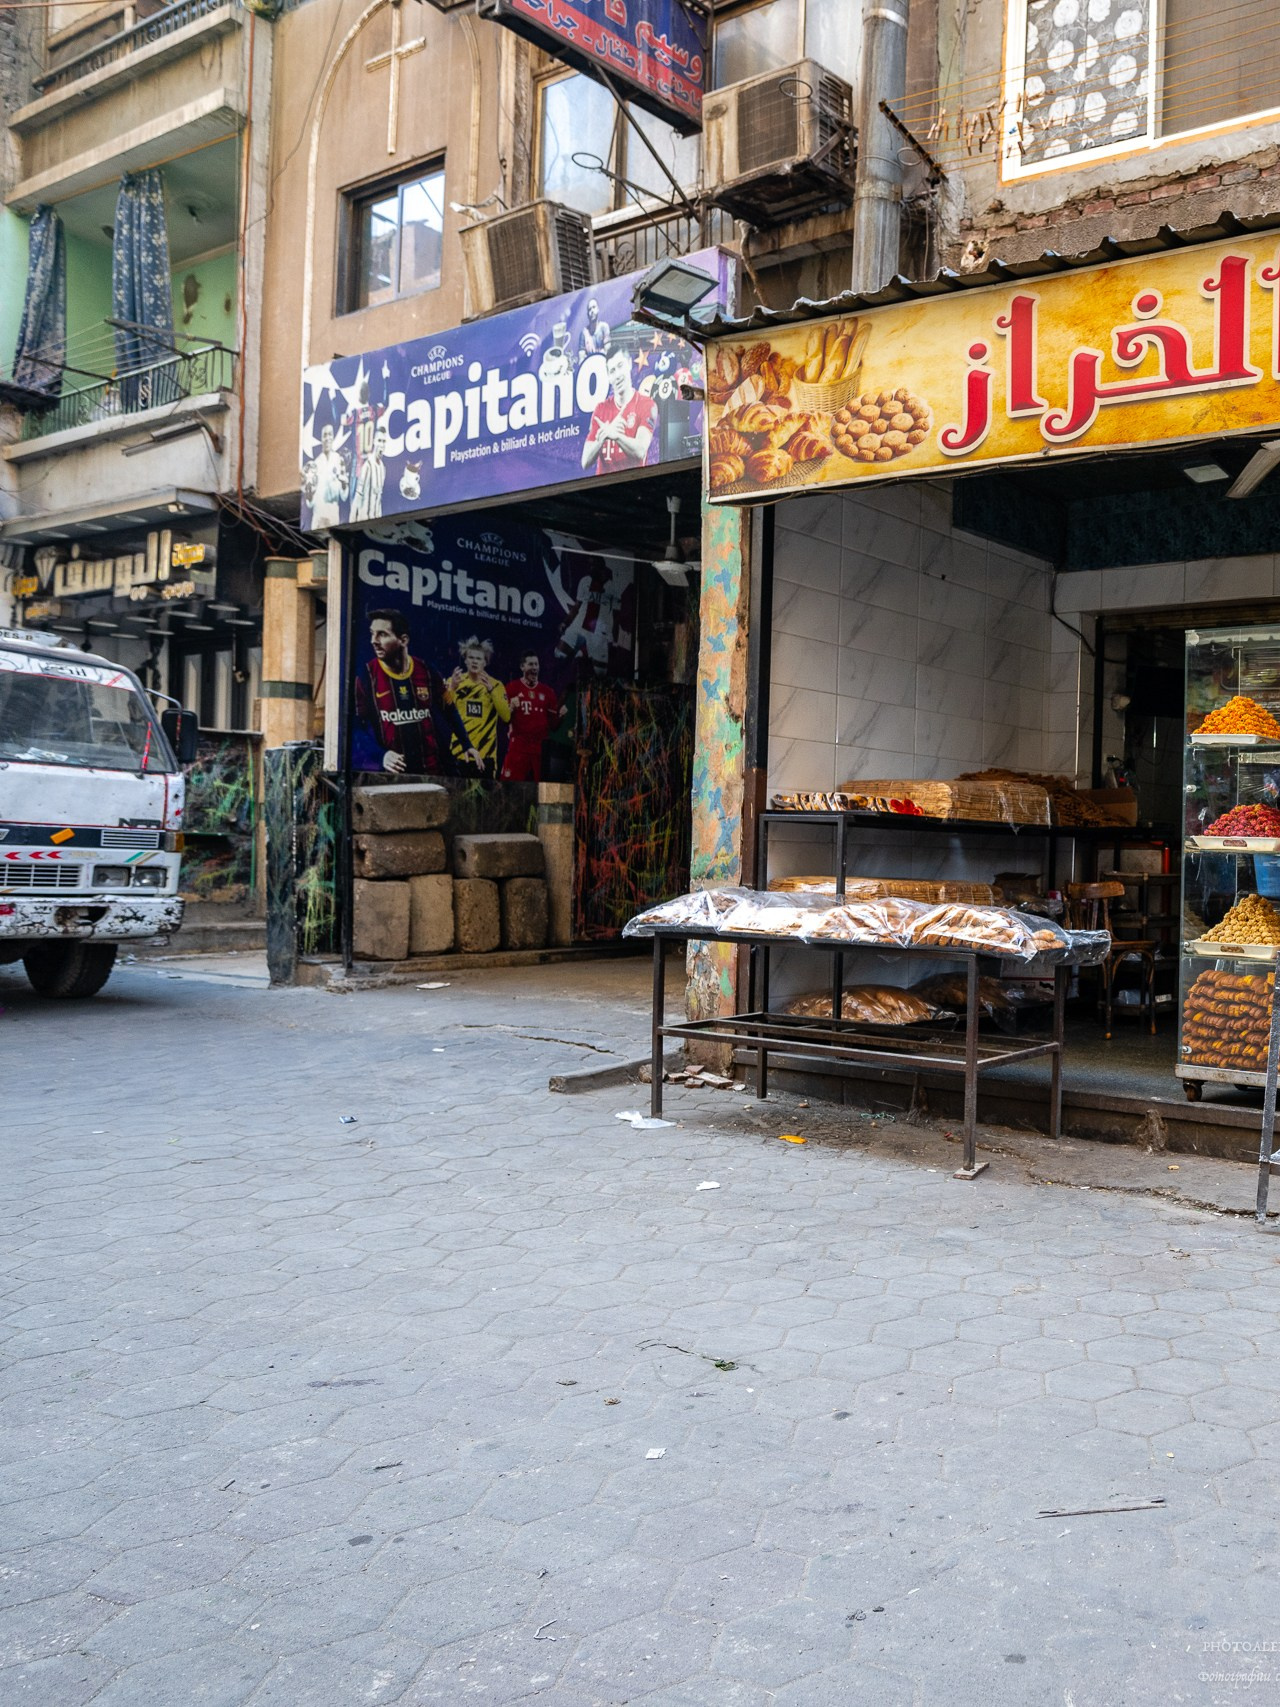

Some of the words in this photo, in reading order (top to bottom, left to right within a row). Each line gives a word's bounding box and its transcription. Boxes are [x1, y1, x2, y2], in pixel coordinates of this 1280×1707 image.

[635, 21, 703, 83] وسيم
[411, 354, 464, 377] CHAMPIONS
[424, 371, 452, 385] LEAGUE
[382, 353, 612, 468] Capitano
[450, 444, 491, 463] Playstation
[492, 442, 499, 453] &
[501, 434, 527, 452] billiard
[529, 434, 536, 445] &
[538, 431, 553, 443] Hot
[554, 424, 580, 440] drinks
[456, 537, 527, 562] CHAMPIONS
[474, 553, 510, 567] LEAGUE
[358, 550, 546, 618] Capitano
[427, 600, 467, 614] Playstation
[476, 609, 500, 620] billiard
[522, 619, 543, 629] drinks
[380, 708, 432, 723] Rakuten
[467, 702, 482, 715] 1&1
